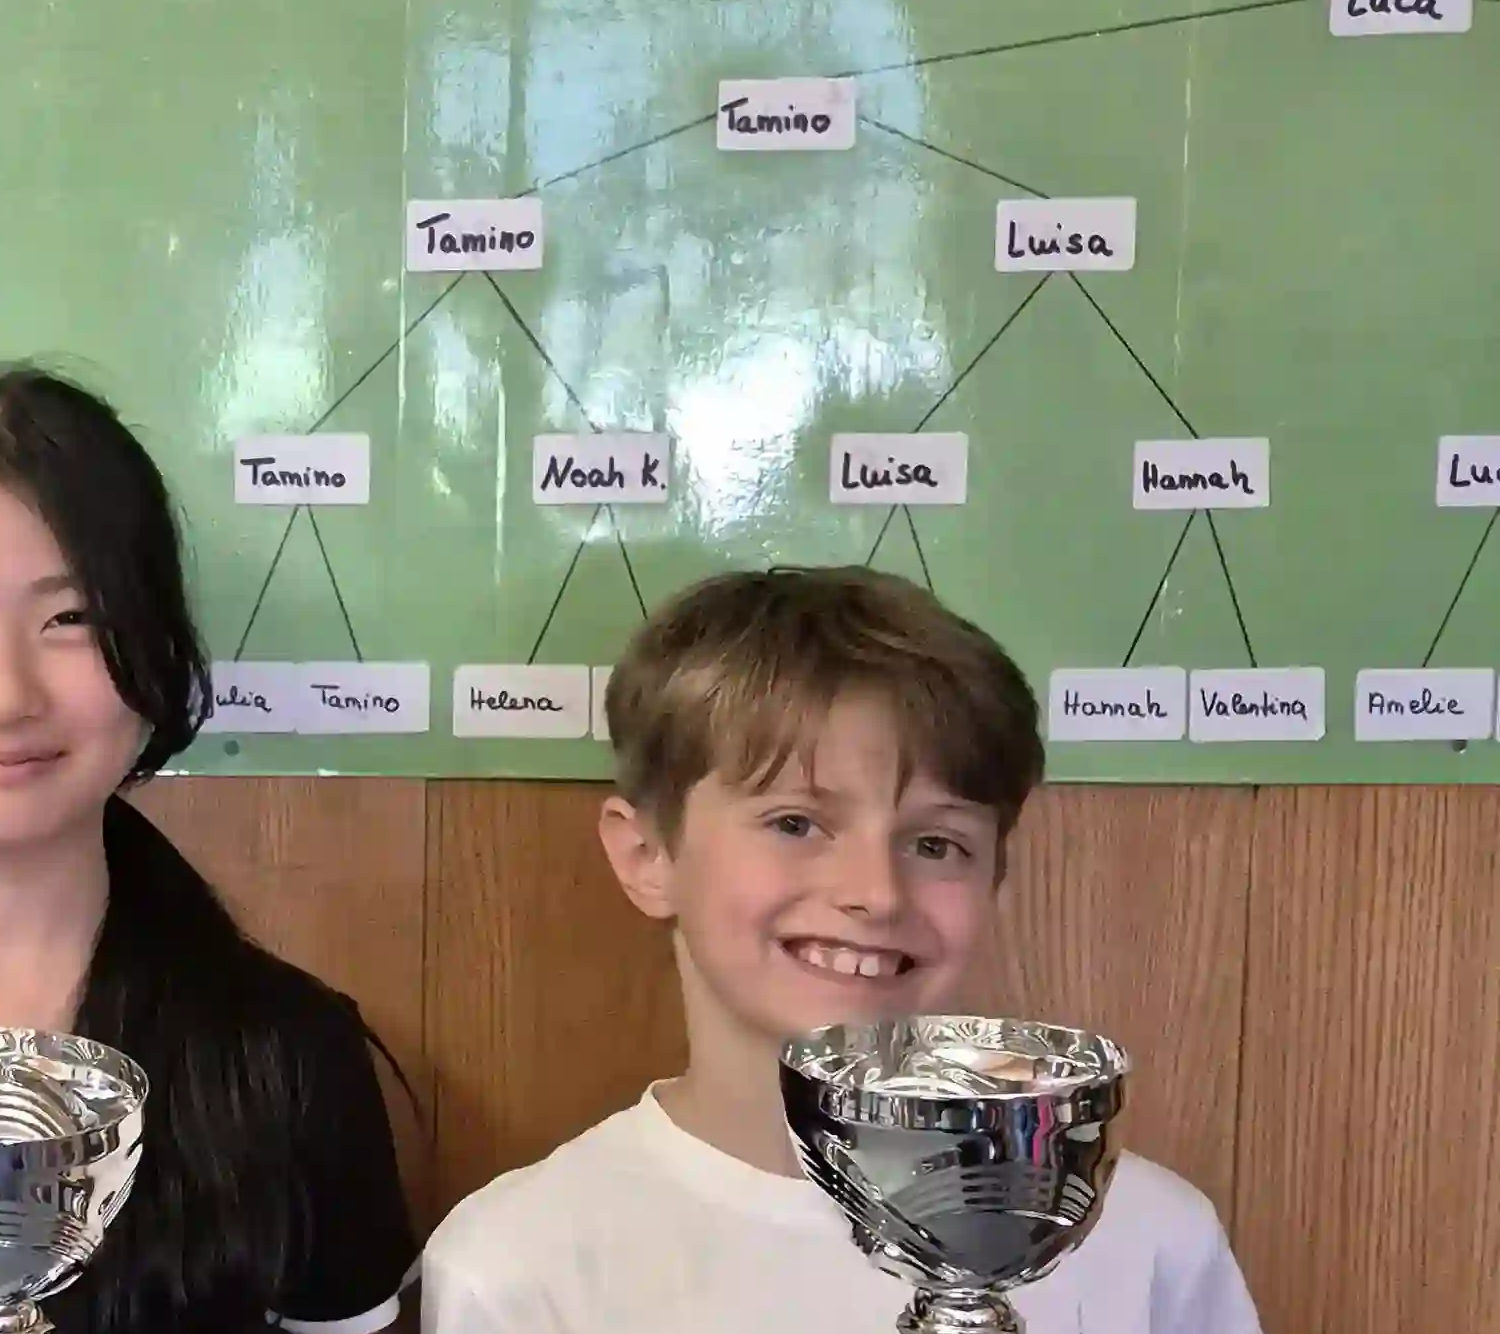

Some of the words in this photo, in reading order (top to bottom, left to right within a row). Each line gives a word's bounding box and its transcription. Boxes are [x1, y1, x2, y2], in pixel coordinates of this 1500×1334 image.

[721, 97, 832, 134] Tamino
[416, 213, 536, 255] Tamino
[1007, 220, 1114, 259] Luisa
[240, 457, 346, 488] Tamino
[540, 455, 625, 491] Noah
[641, 452, 667, 490] K.
[842, 451, 938, 490] Luisa
[1142, 459, 1255, 495] Hannah
[1450, 453, 1500, 487] Lu
[215, 685, 273, 714] ulia
[310, 683, 401, 713] Tamino
[470, 687, 564, 712] Helena
[1063, 688, 1168, 718] Hannah
[1200, 687, 1308, 721] Valentina
[1368, 687, 1465, 716] Amelie
